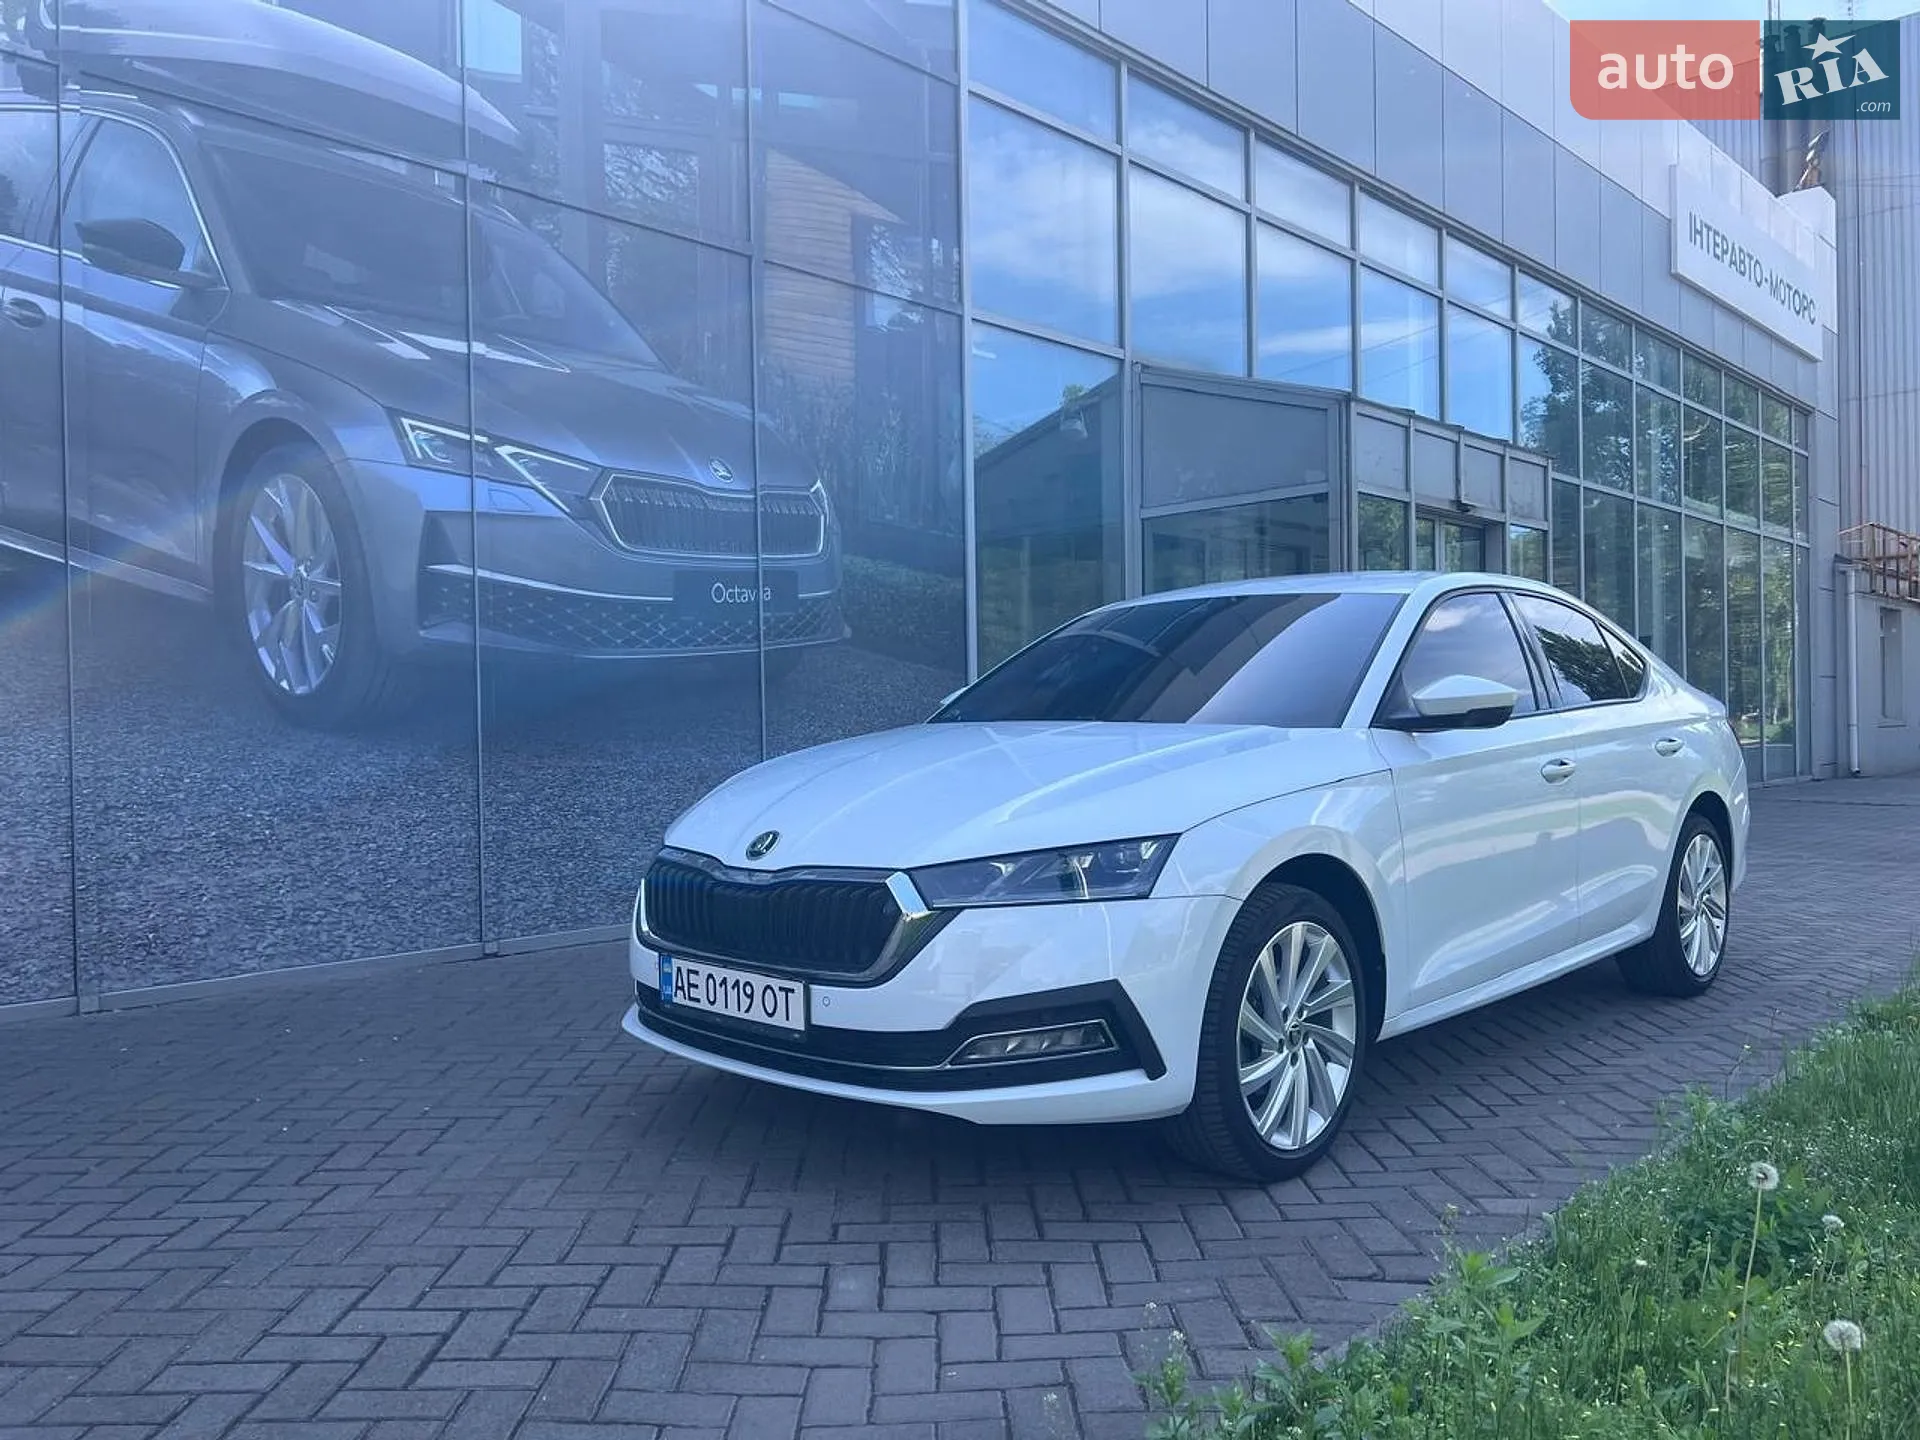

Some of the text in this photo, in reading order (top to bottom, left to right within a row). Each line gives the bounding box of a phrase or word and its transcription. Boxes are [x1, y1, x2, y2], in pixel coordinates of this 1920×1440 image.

[1688, 211, 1817, 325] ІНТЕРАВТО-МОТОРС
[711, 582, 771, 604] Octava
[674, 966, 701, 1003] AE
[705, 973, 755, 1014] 0119
[761, 984, 795, 1021] OT
